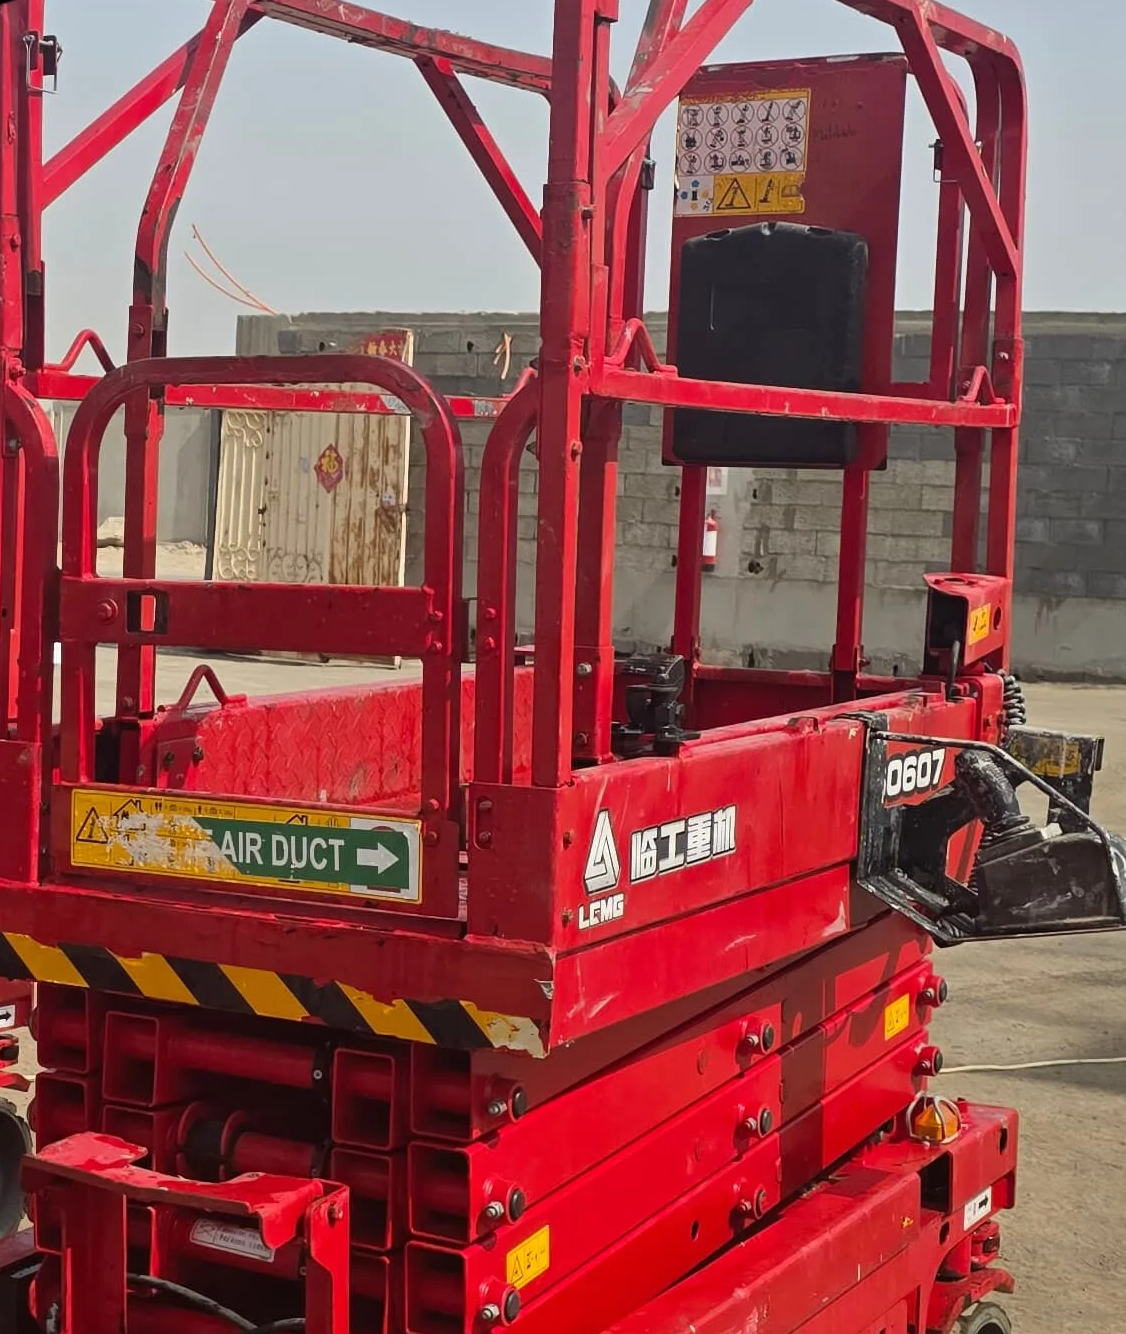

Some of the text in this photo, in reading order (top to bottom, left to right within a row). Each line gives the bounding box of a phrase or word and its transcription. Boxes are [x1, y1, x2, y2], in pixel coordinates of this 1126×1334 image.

[222, 830, 345, 872] AIR DUCT
[631, 805, 737, 881] 临工重机
